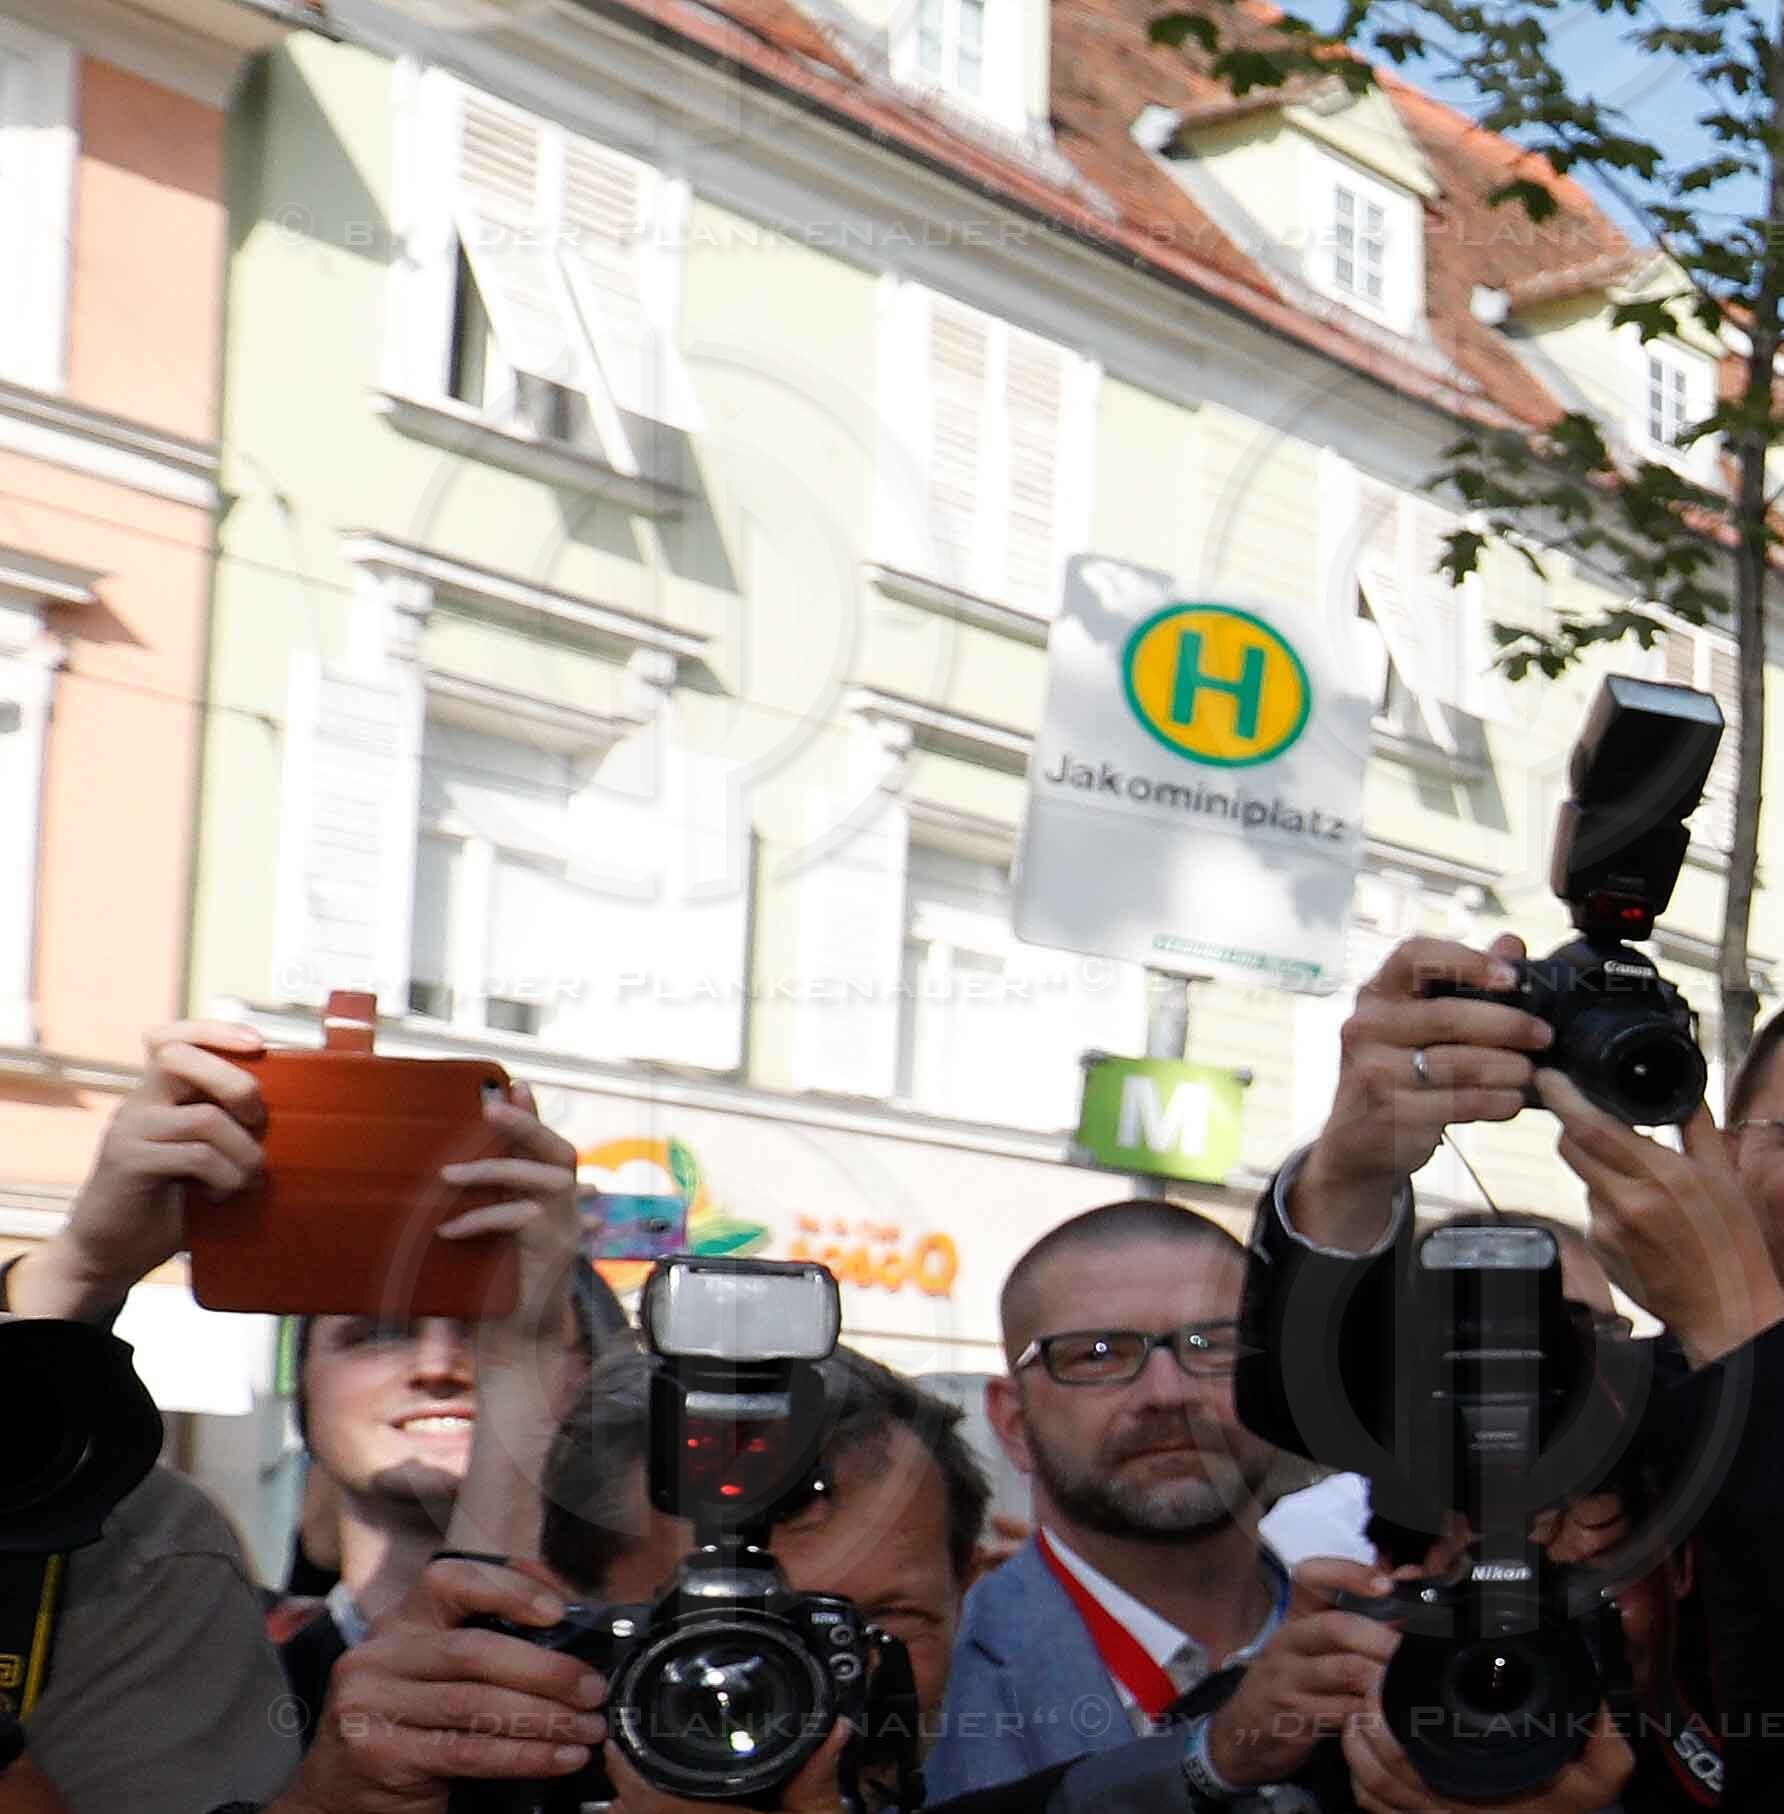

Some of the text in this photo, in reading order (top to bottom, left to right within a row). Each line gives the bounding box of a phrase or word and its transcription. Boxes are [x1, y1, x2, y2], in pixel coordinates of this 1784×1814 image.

[1044, 752, 1351, 843] Jakominiplatz
[1115, 1074, 1211, 1158] M
[1471, 1565, 1533, 1582] Nikon
